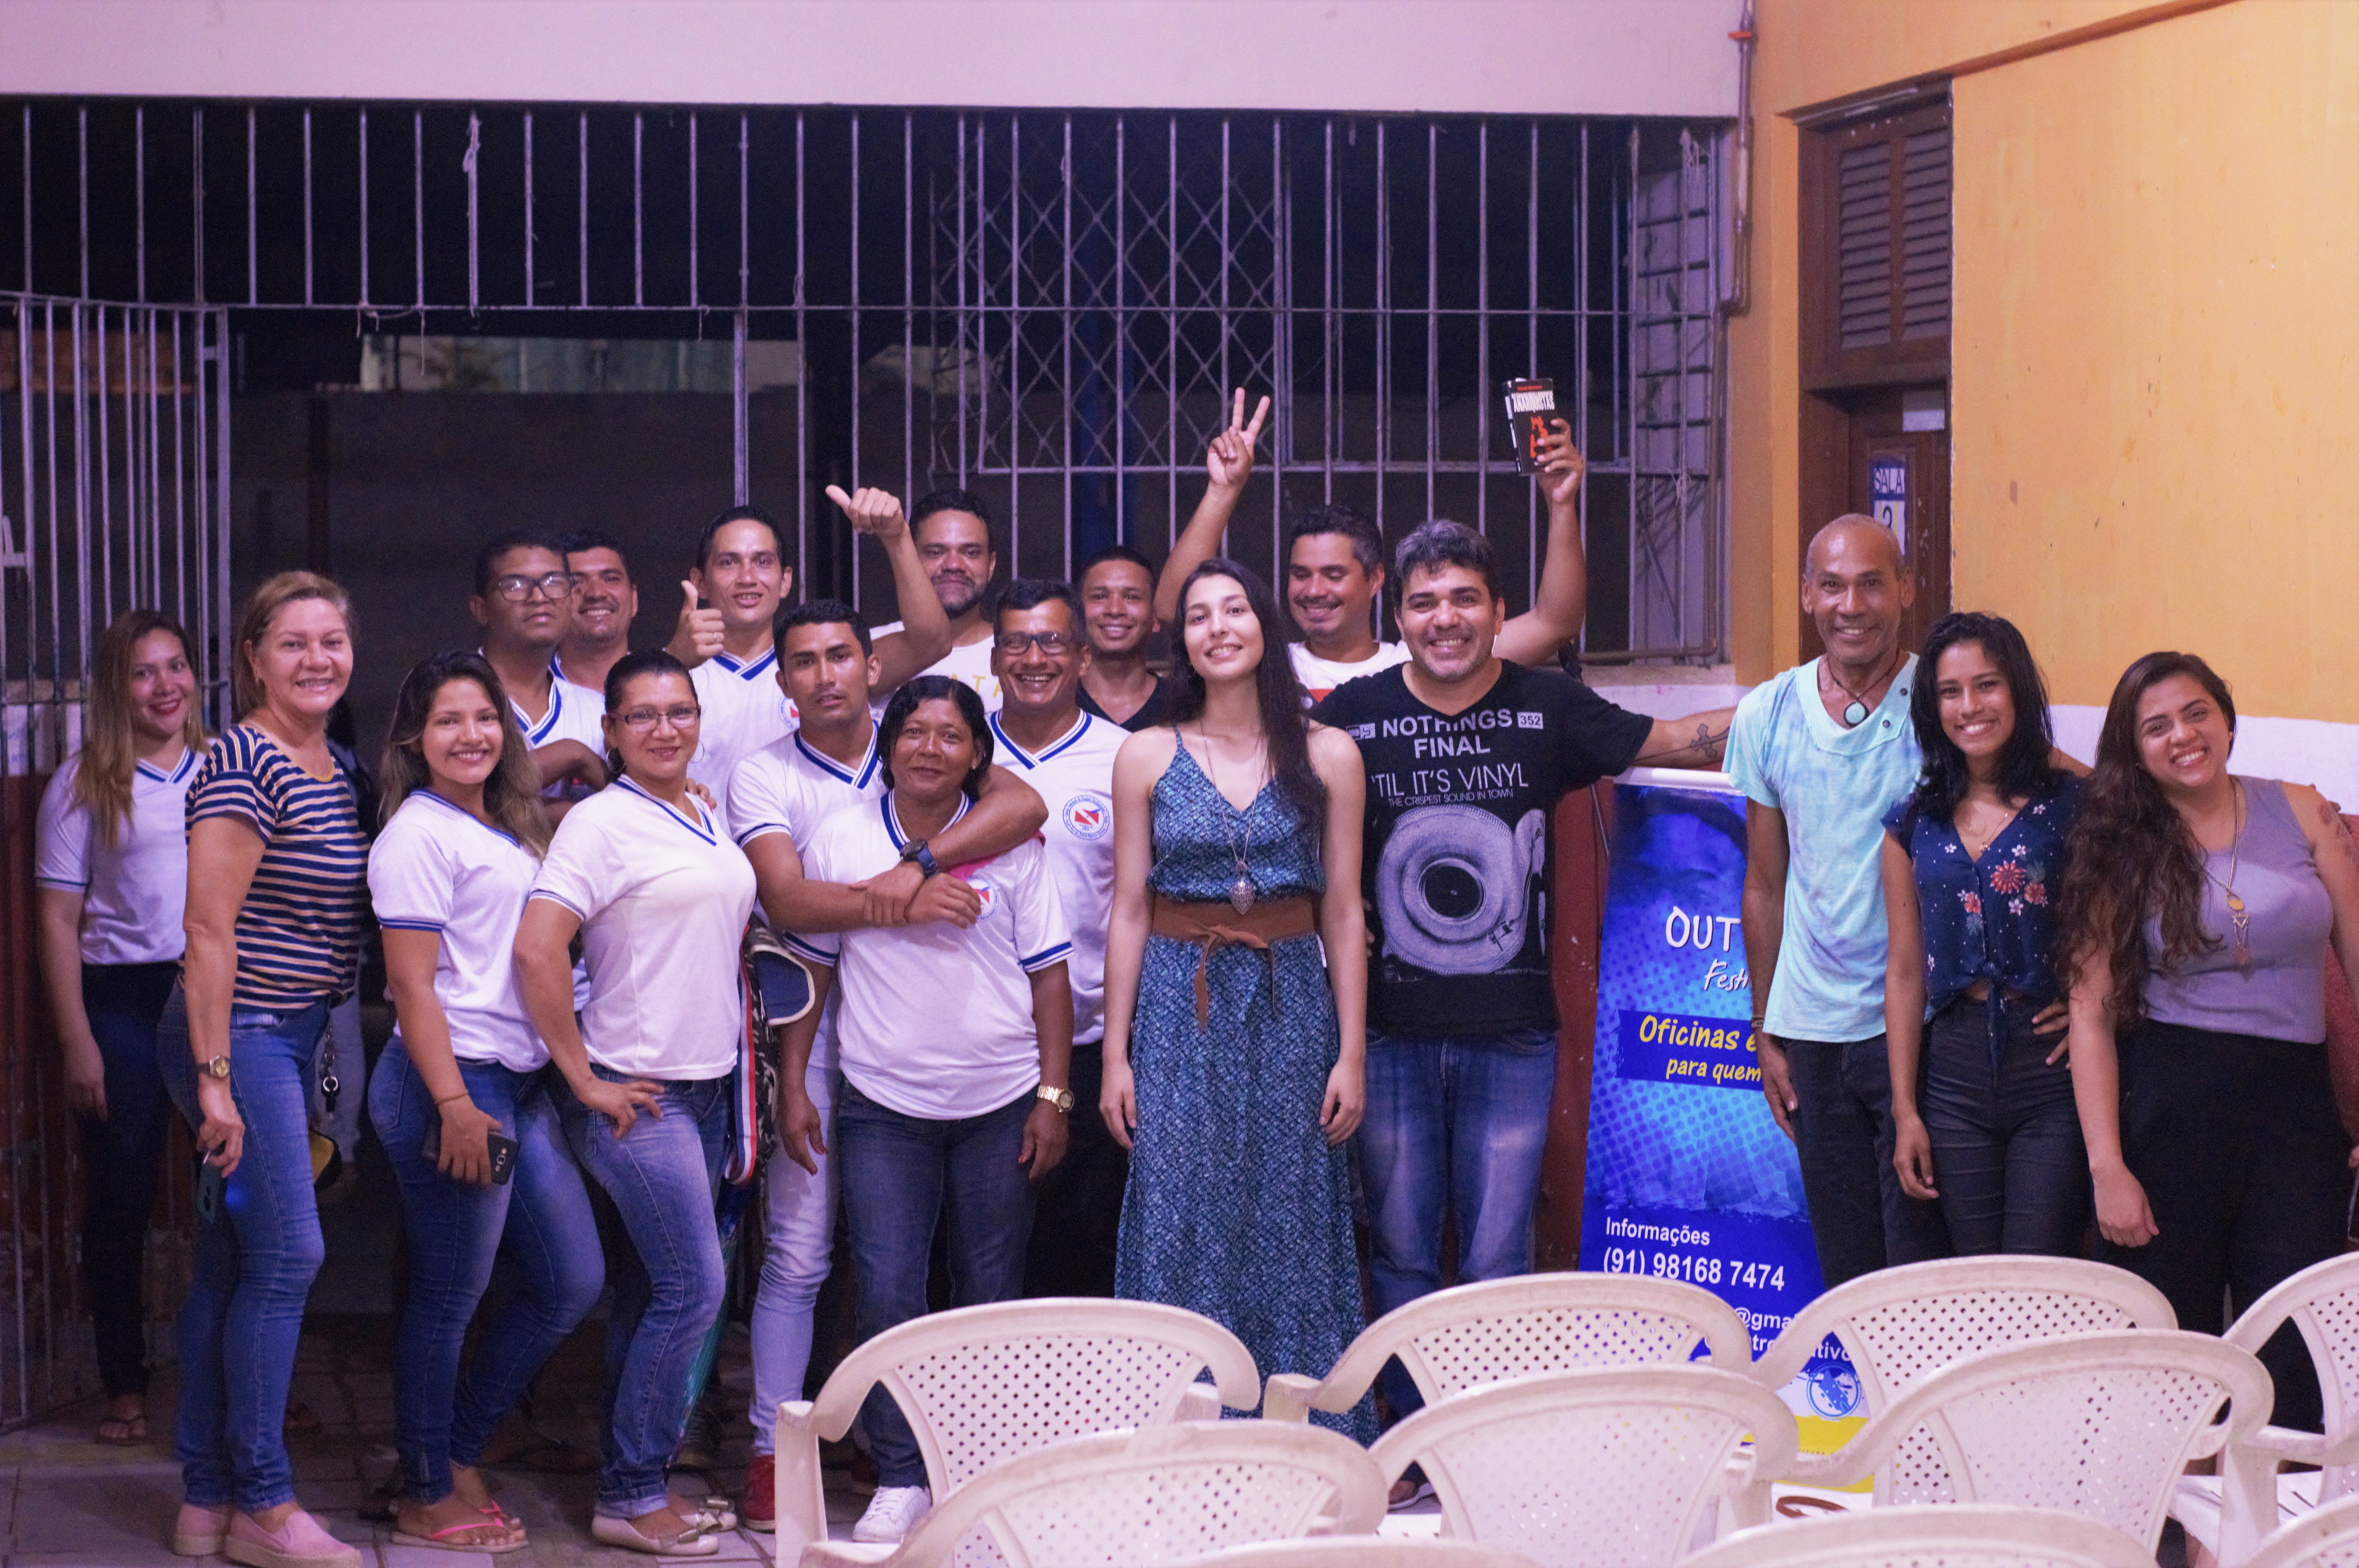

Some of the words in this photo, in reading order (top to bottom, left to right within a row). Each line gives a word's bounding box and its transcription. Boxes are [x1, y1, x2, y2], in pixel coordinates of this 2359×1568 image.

[1875, 468, 1903, 494] SALA
[1520, 715, 1541, 726] 352
[1414, 735, 1490, 759] FINAL
[1412, 768, 1450, 795] IT'S
[1458, 762, 1529, 790] VINYL
[1388, 797, 1403, 808] THE
[1405, 794, 1441, 806] CRISPEST
[1444, 791, 1475, 803] SOUND
[1477, 790, 1486, 800] IN
[1487, 788, 1513, 799] TOWN
[1639, 1014, 1740, 1051] Oficinas
[1666, 1058, 1707, 1080] para
[1712, 1063, 1762, 1084] quem
[1606, 1217, 1710, 1247] Informações
[1603, 1247, 1646, 1275] (91)
[1653, 1252, 1722, 1285] 98168
[1730, 1260, 1785, 1291] 7474
